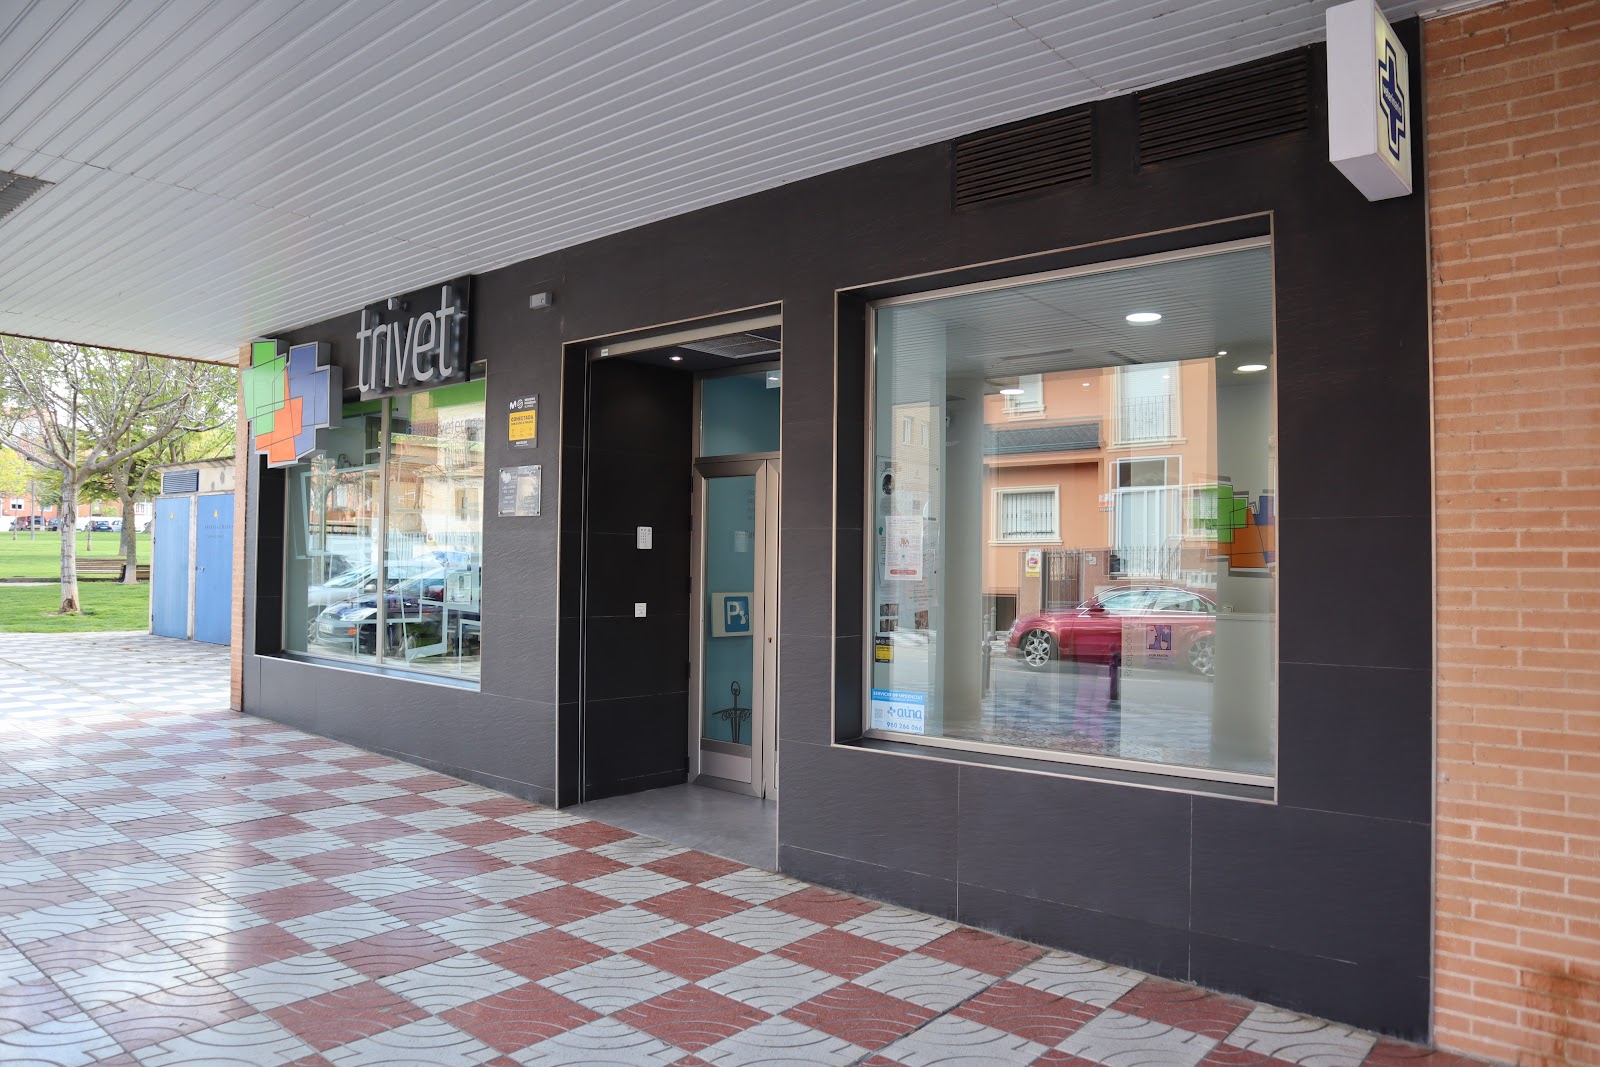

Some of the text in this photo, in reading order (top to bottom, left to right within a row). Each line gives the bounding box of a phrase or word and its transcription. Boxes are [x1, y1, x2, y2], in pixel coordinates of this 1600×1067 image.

[356, 285, 454, 392] trivet
[727, 601, 740, 625] P
[896, 706, 922, 719] aúna
